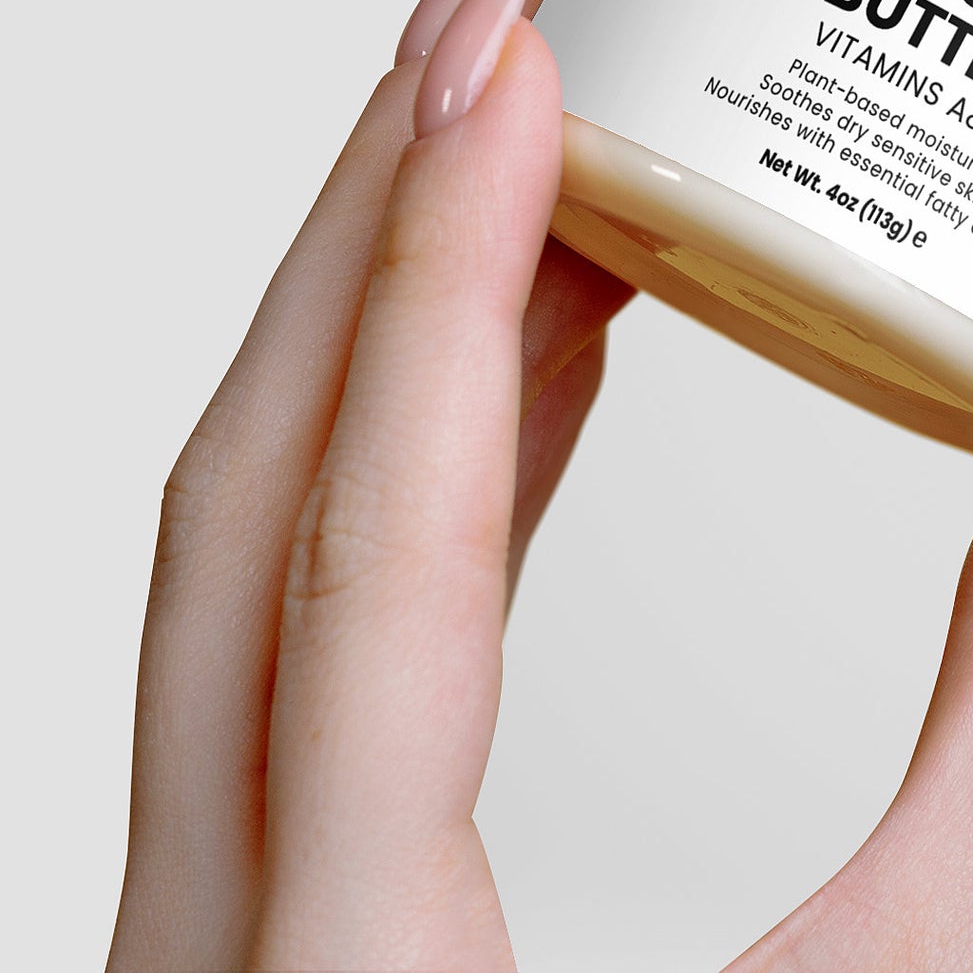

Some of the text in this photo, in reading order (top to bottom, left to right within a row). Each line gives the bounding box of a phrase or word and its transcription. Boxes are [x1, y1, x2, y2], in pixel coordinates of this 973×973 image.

[787, 58, 907, 130] Plant-based
[815, 20, 944, 106] VITAMINS
[703, 76, 793, 131] Nourishes
[796, 122, 836, 154] with
[839, 147, 926, 201] essential
[924, 190, 970, 231] fatty
[759, 73, 834, 122] Soothes
[836, 114, 870, 144] dry
[870, 133, 952, 187] sensitive
[758, 147, 794, 178] Net
[793, 164, 822, 195] Wt.
[824, 183, 860, 213] 4oz
[858, 197, 914, 244] (113g)
